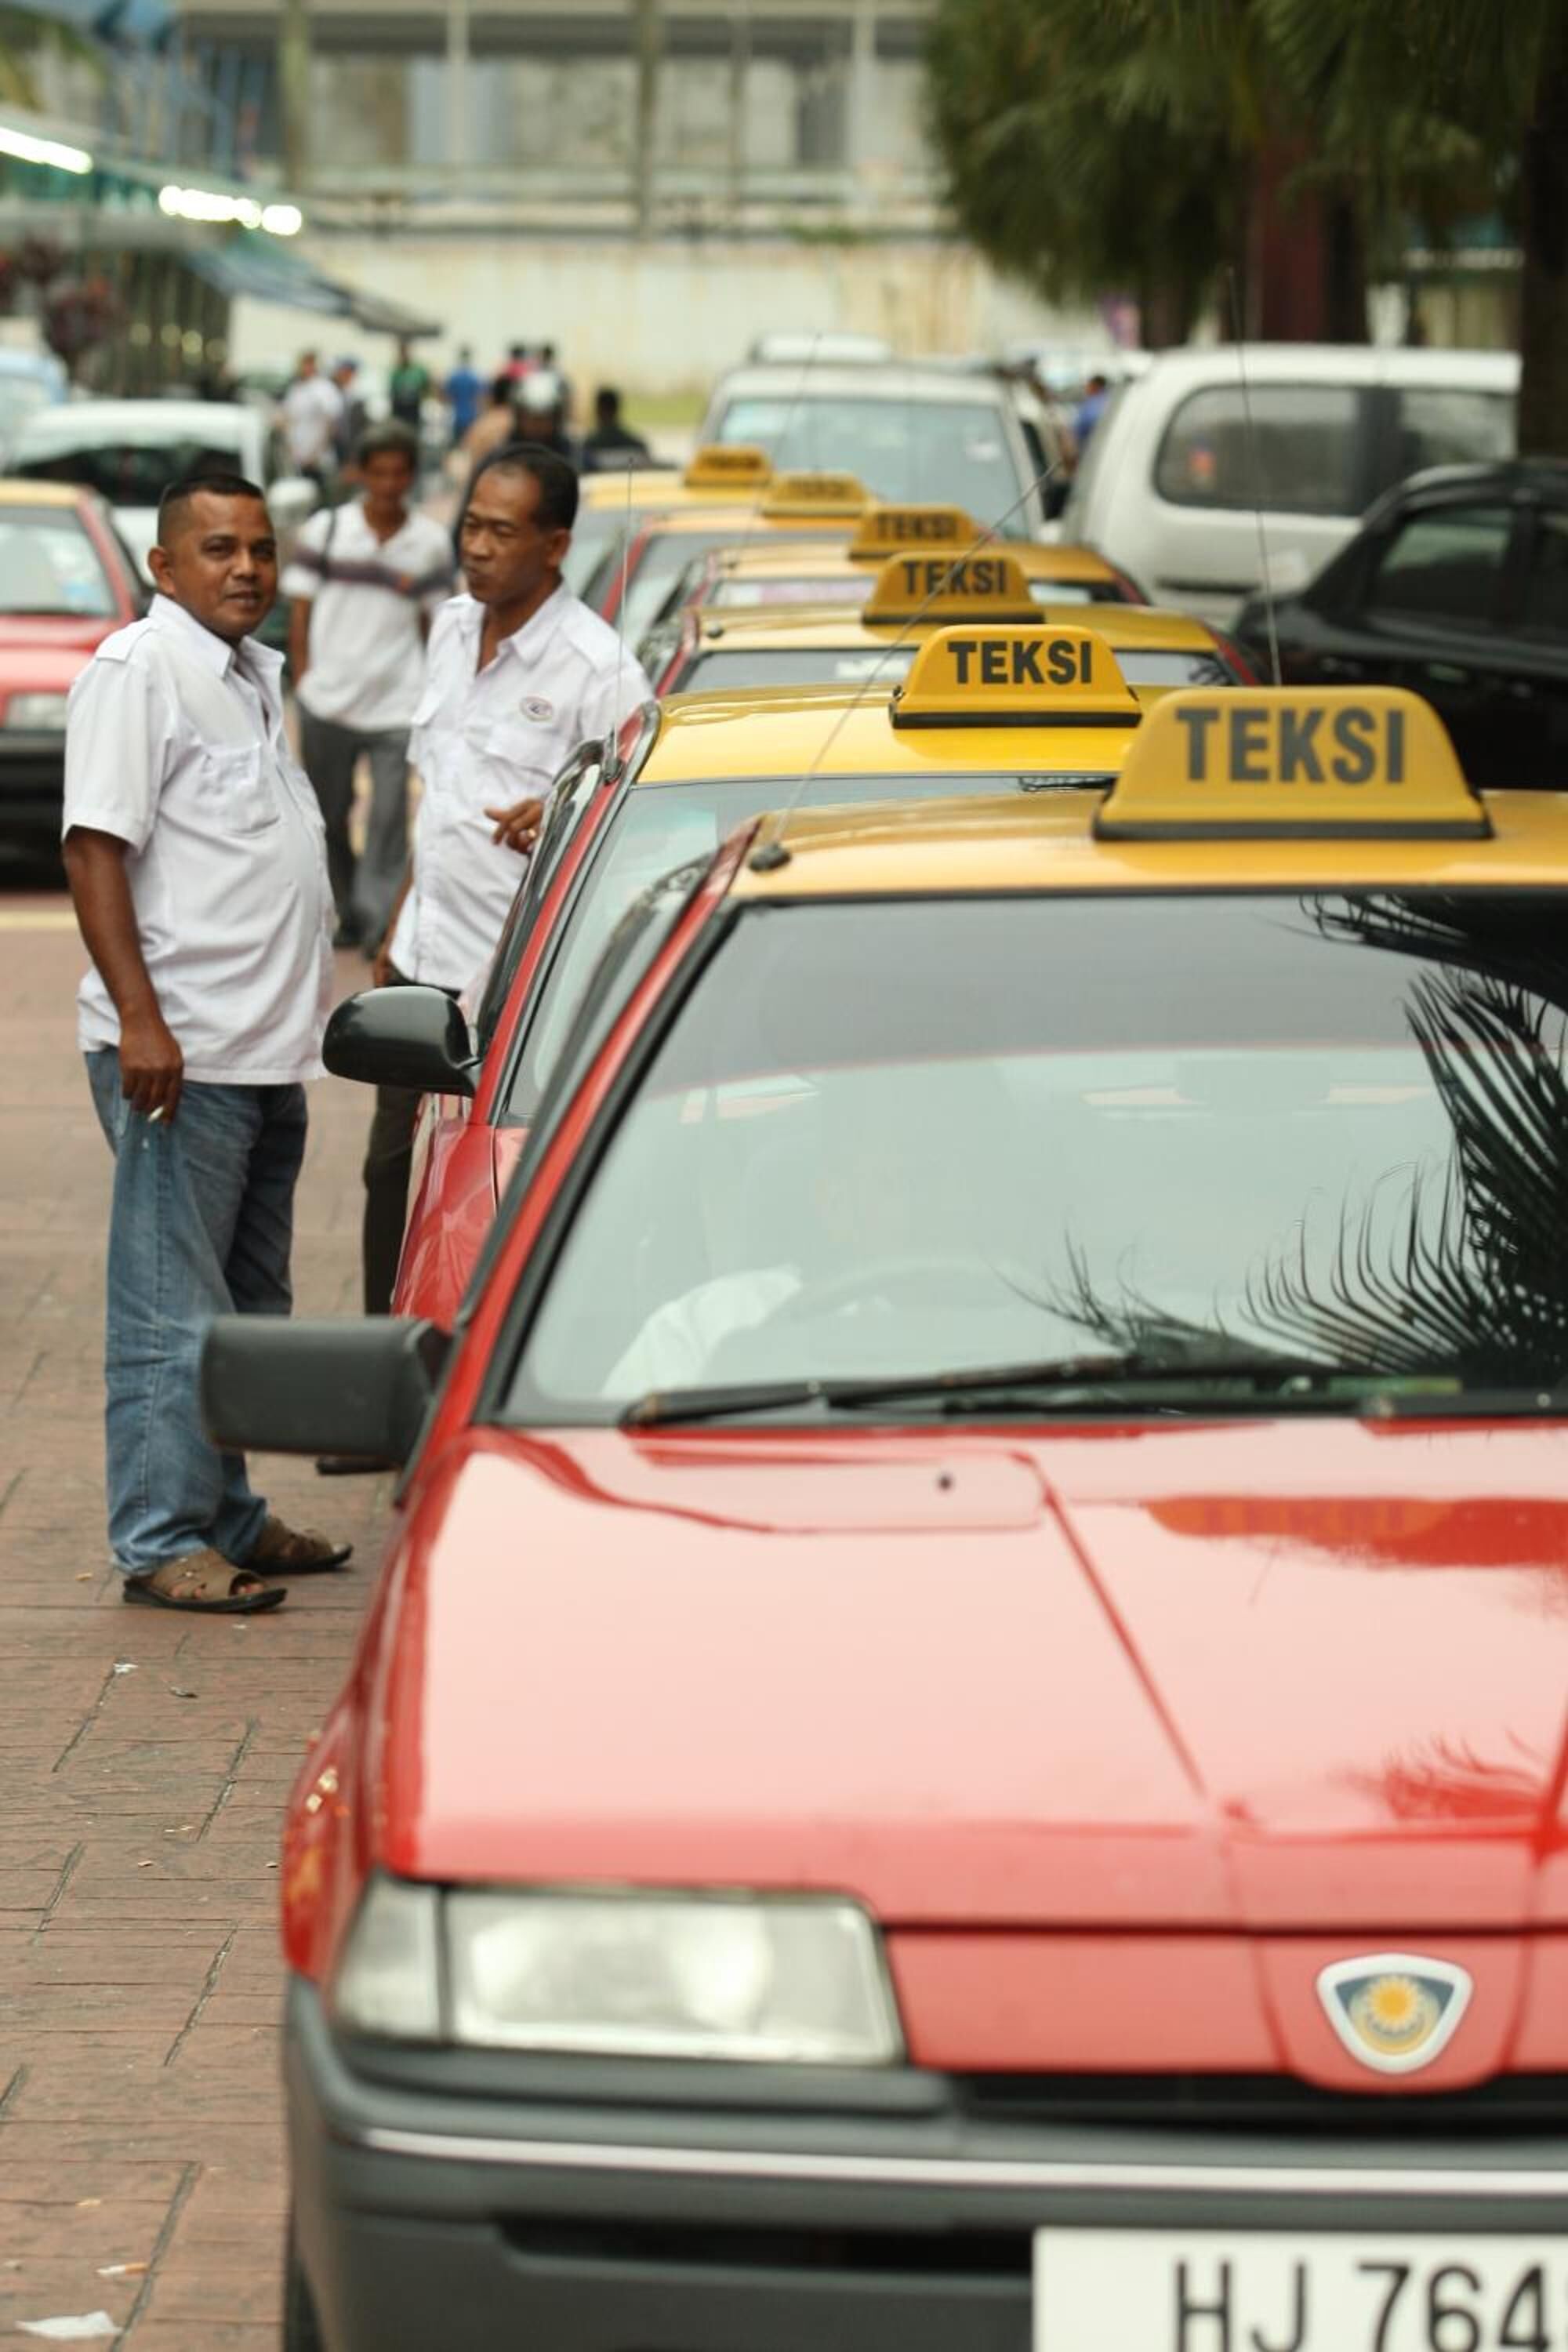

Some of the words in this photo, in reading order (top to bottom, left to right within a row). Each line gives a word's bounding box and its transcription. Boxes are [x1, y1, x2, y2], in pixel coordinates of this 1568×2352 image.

[904, 560, 1006, 595] TEKSI
[947, 640, 1092, 684] TEKSI
[1177, 708, 1403, 784] TEKSI
[1176, 2260, 1305, 2352] HJ
[1358, 2261, 1568, 2352] 764
